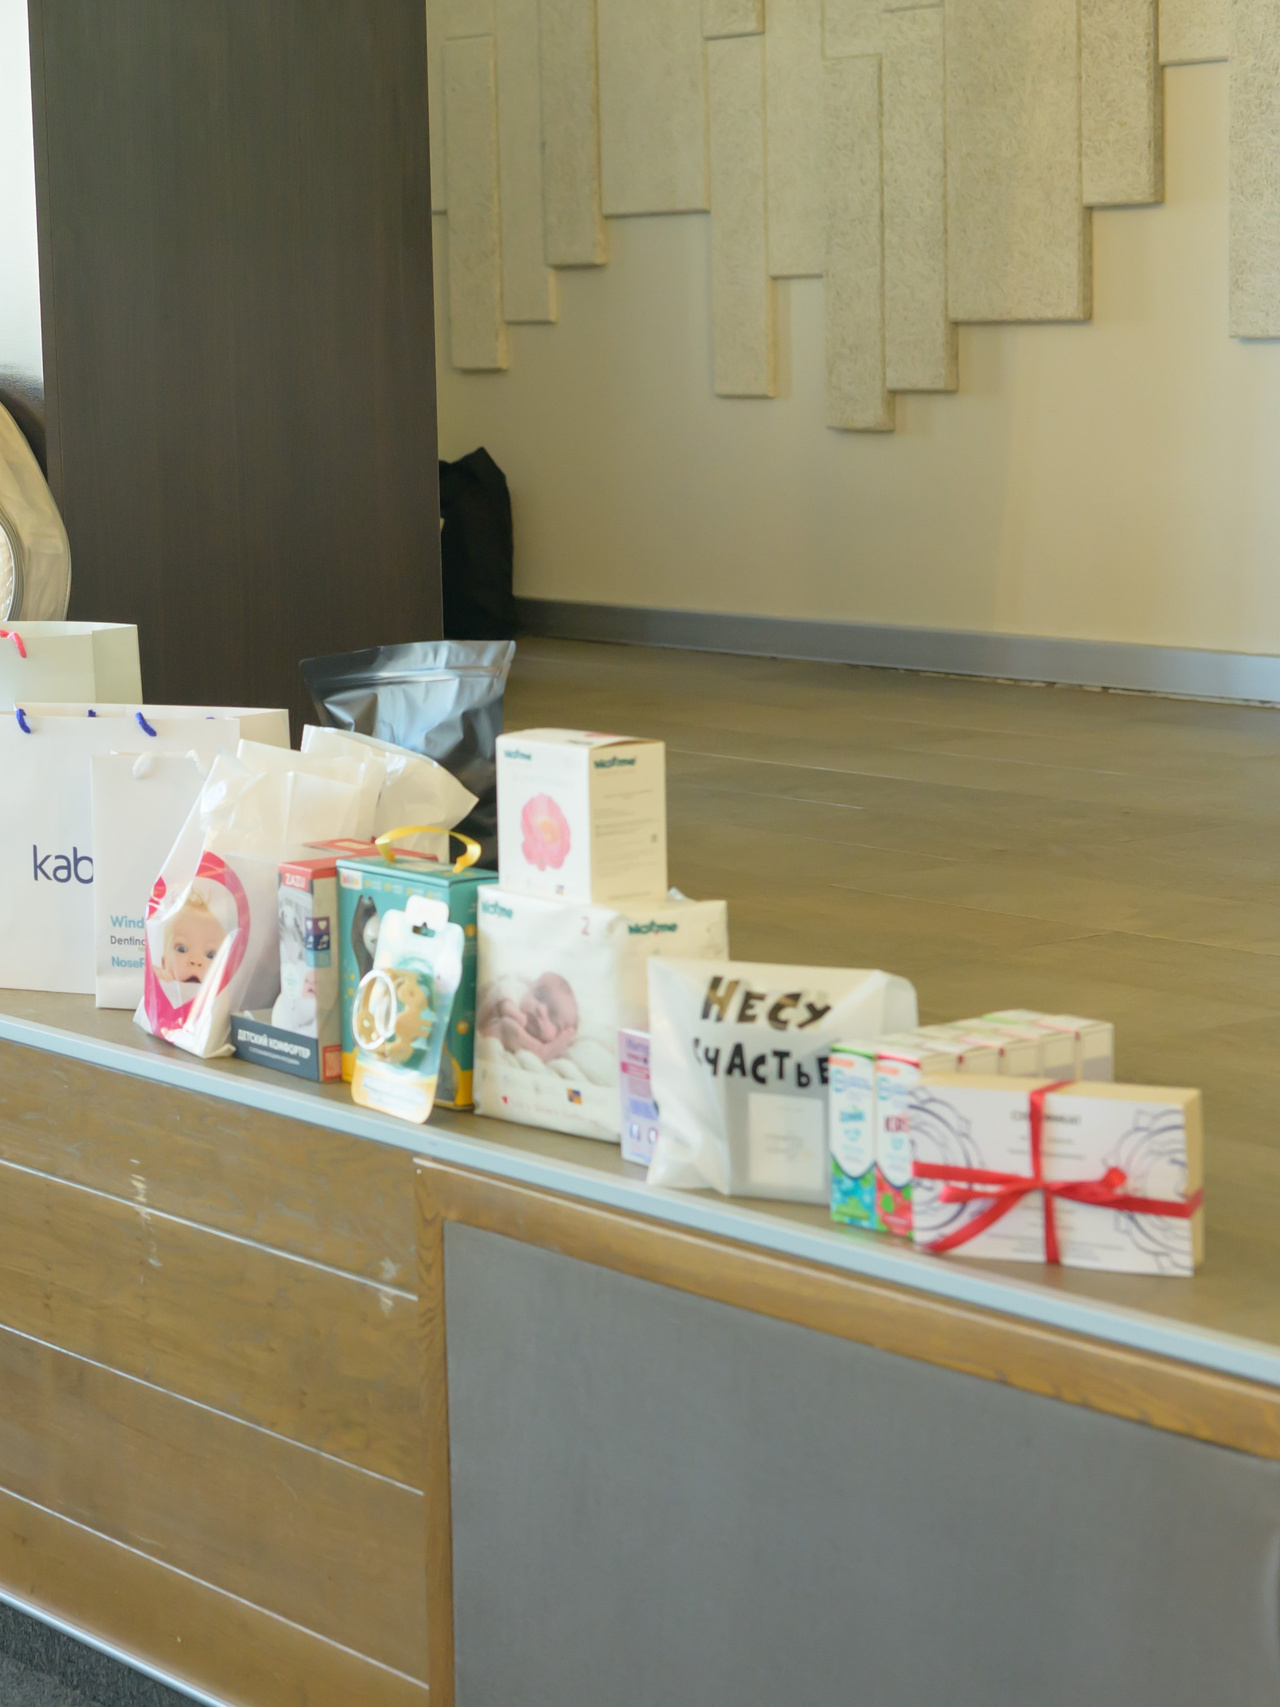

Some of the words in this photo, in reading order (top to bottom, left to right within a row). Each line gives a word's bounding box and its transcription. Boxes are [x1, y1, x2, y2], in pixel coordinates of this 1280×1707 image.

[701, 976, 831, 1031] НЕСУ
[238, 1029, 268, 1046] ДЕТСКИЙ
[268, 1037, 311, 1059] КОМФОРТЕР
